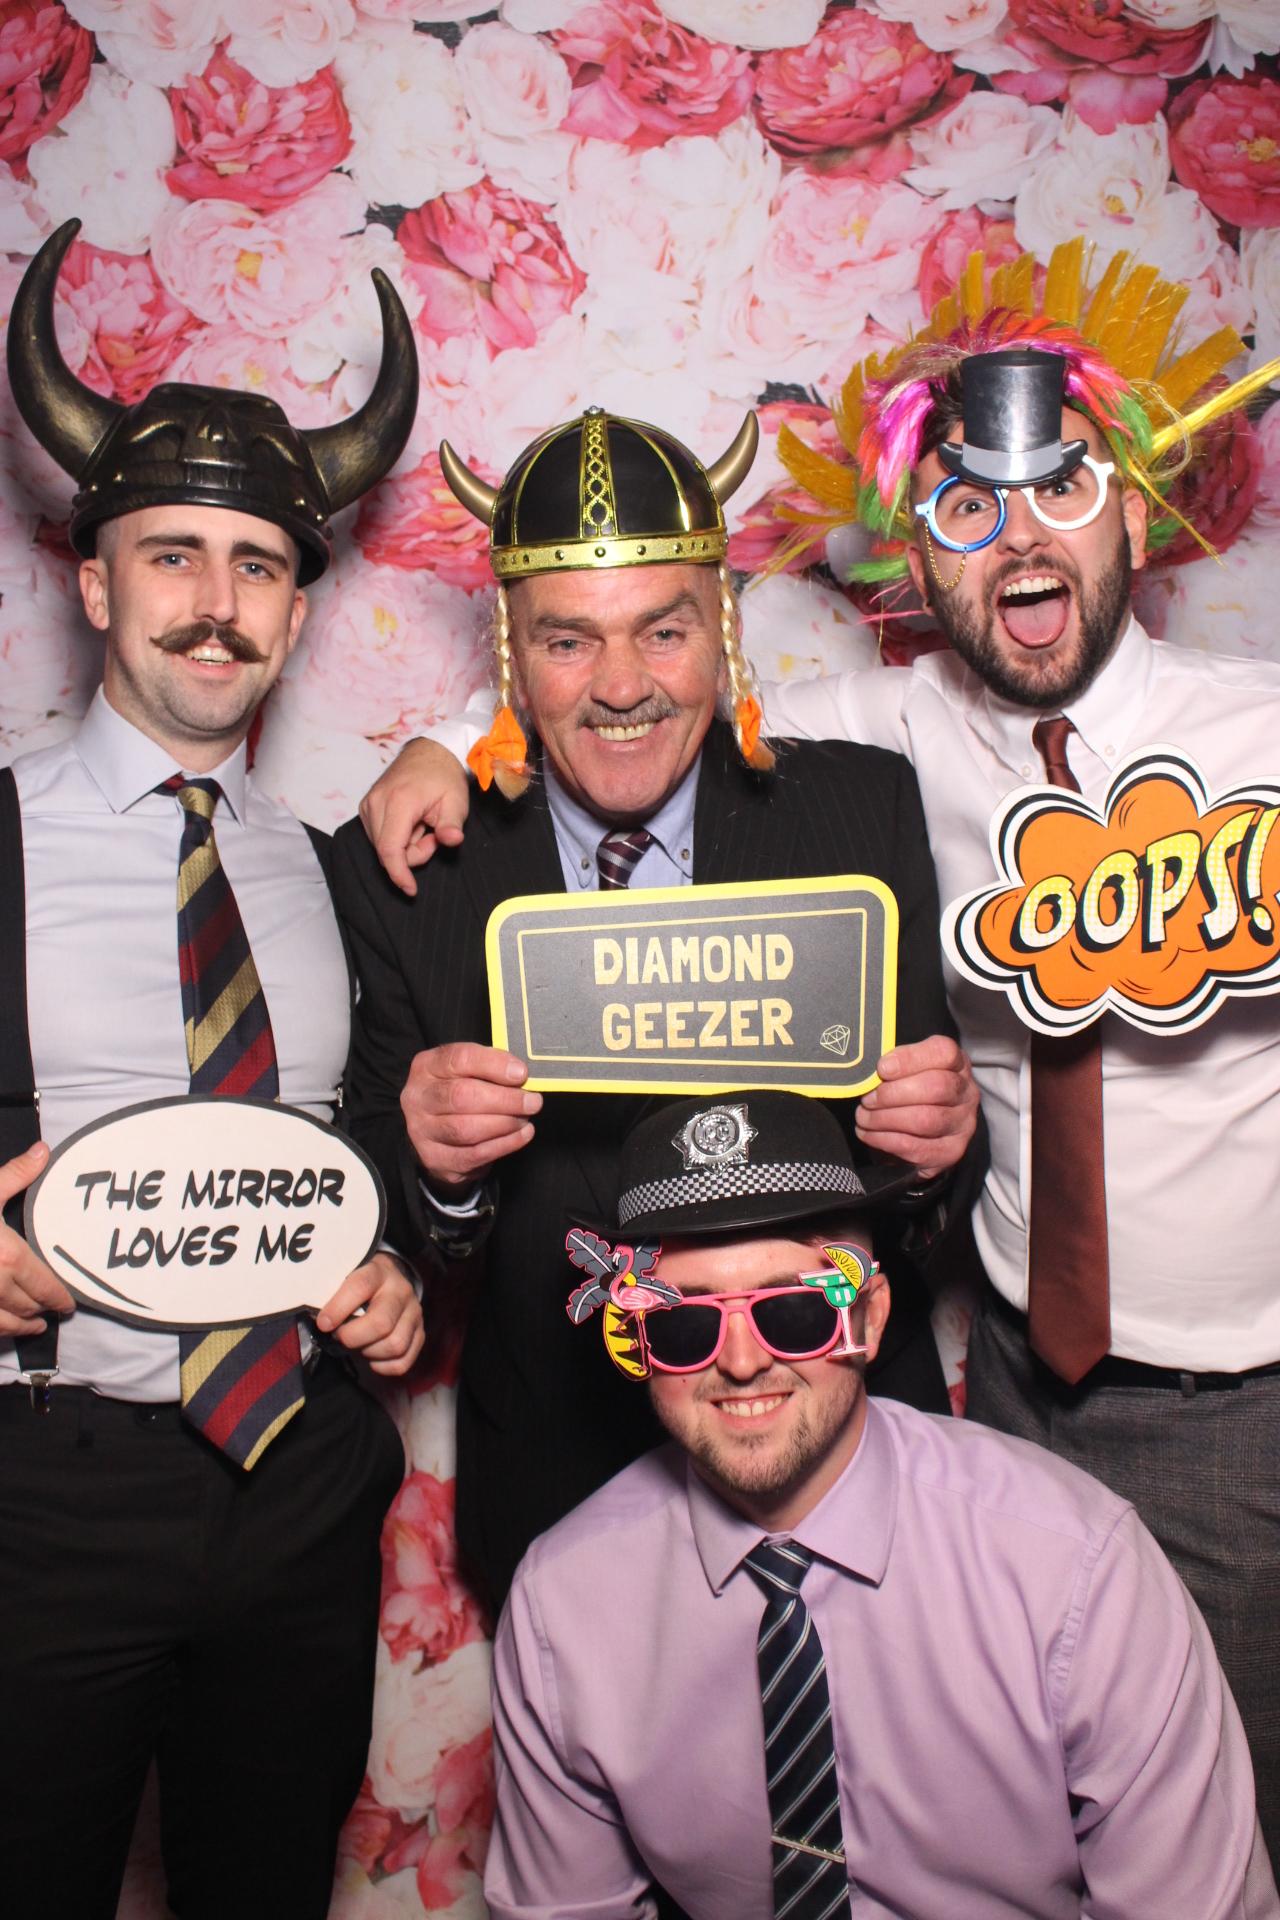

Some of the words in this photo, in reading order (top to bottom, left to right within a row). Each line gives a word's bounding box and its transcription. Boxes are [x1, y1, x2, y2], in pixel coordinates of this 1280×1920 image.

[1012, 808, 1280, 951] OOPS!
[593, 933, 794, 985] DIAMOND
[602, 997, 795, 1051] GEEZER
[75, 1170, 166, 1211] THE
[181, 1168, 346, 1210] MIRROR
[107, 1225, 240, 1269] LOVES
[254, 1223, 316, 1265] ME
